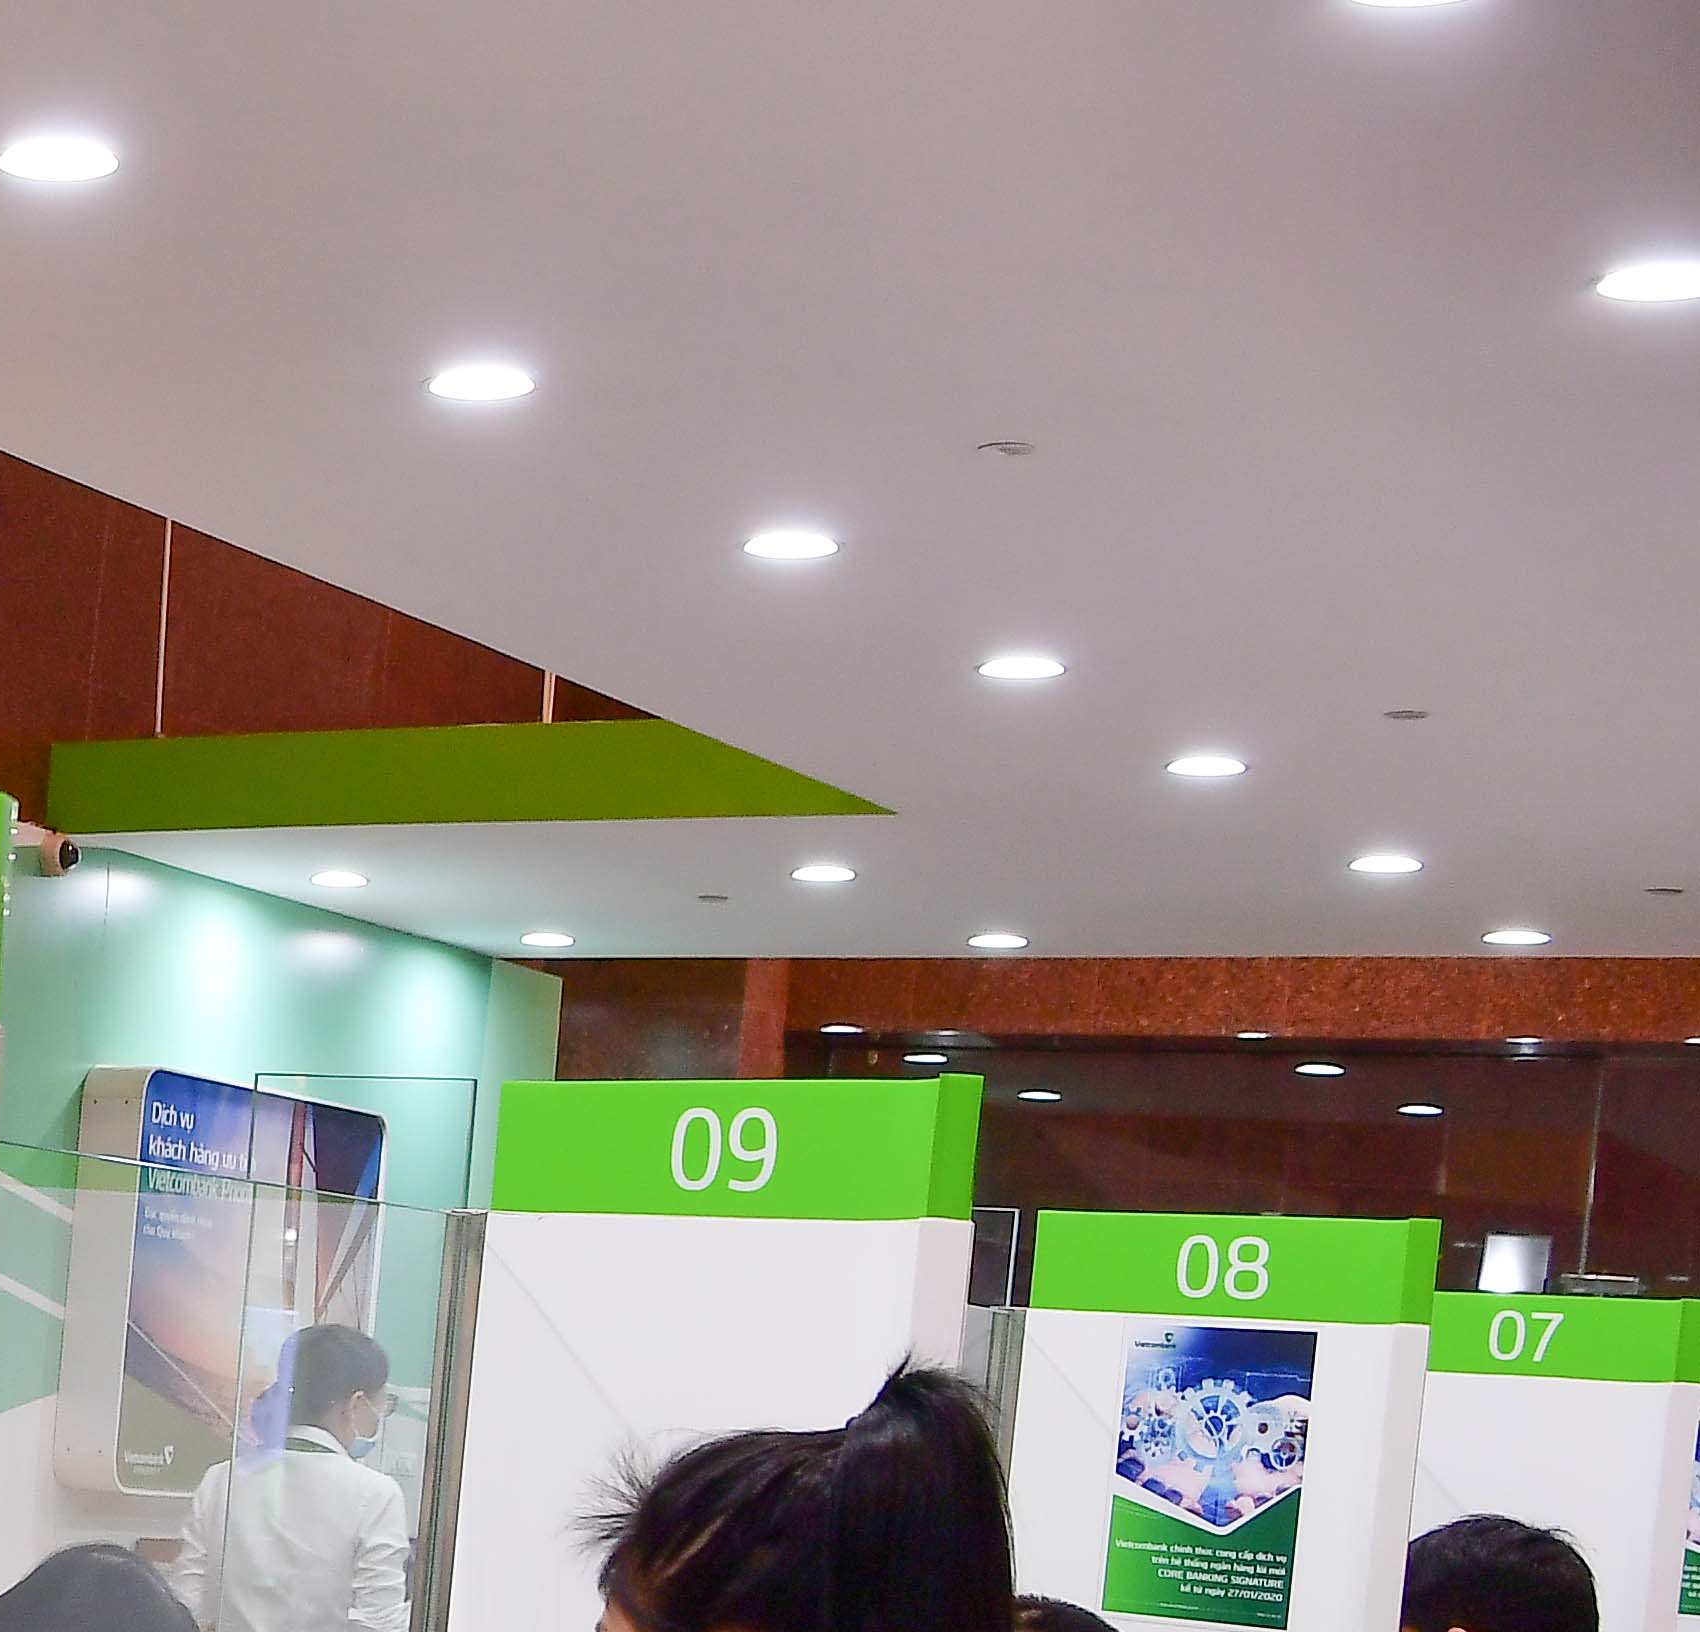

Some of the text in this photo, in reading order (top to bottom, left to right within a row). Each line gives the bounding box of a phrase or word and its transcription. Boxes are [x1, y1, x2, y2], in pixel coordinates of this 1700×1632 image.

[149, 1134, 187, 1161] khách
[670, 1106, 778, 1193] 09
[1175, 1233, 1271, 1301] 08
[1486, 1309, 1565, 1363] 07
